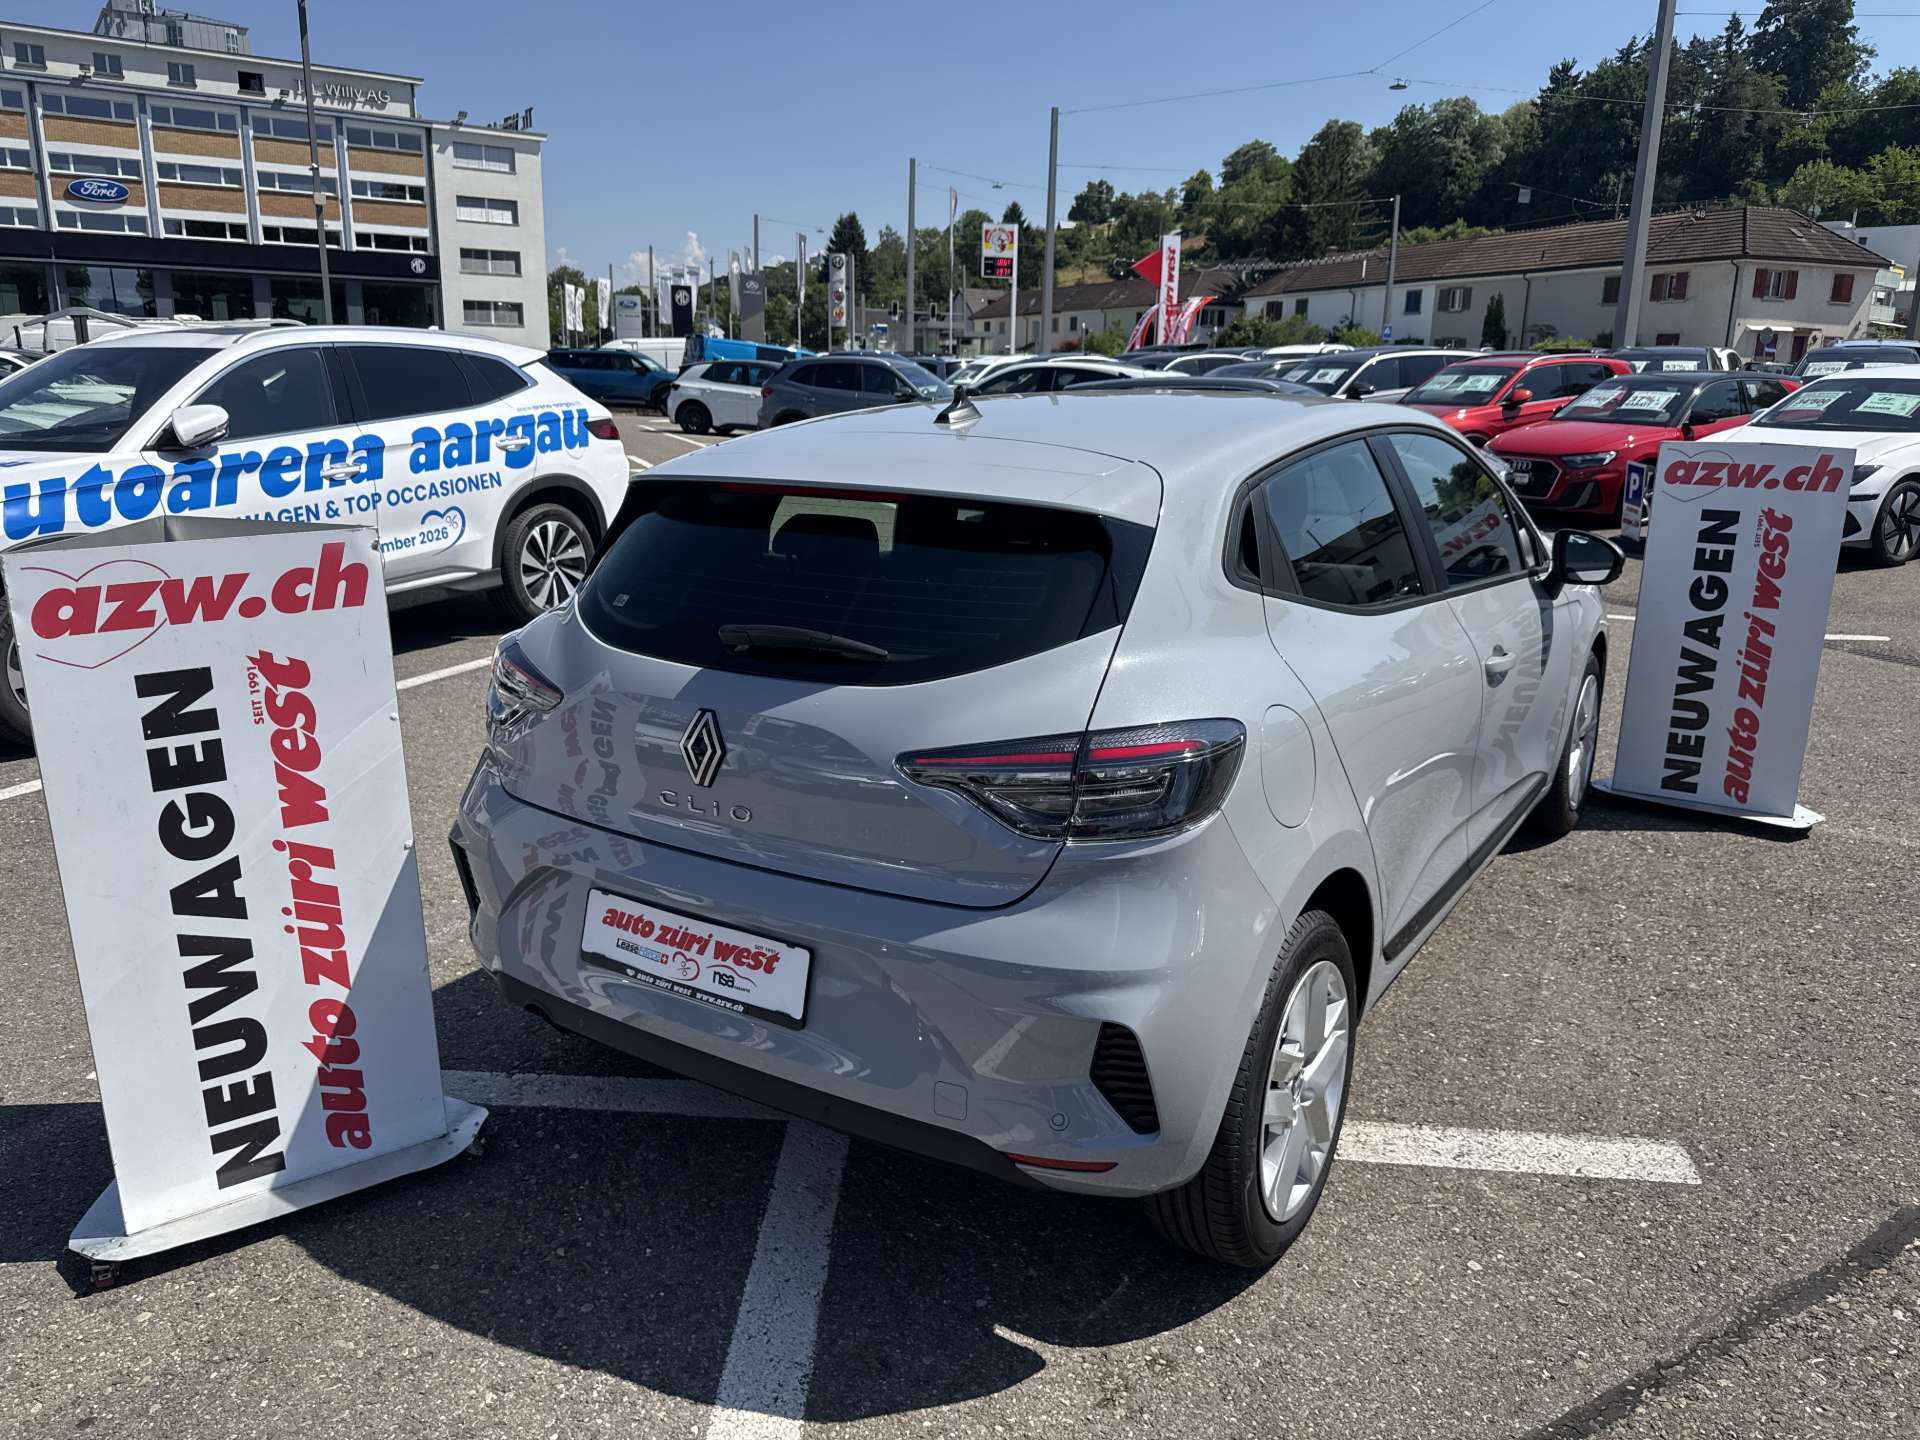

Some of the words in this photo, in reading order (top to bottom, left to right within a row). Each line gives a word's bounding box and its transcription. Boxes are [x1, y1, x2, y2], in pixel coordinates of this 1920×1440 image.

[367, 89, 390, 103] AG
[81, 181, 118, 197] Ford
[674, 289, 690, 306] MG
[409, 408, 589, 474] aargau
[325, 501, 340, 518] &
[344, 492, 381, 513] TOP
[387, 475, 502, 506] OCCASIONEN
[1629, 472, 1640, 499] P
[1664, 454, 1844, 492] azw.ch
[419, 526, 449, 545] 2026
[1752, 507, 1794, 609] west
[31, 542, 369, 640] azw.ch
[1660, 509, 1740, 794] NEUWAGEN
[1736, 611, 1776, 709] züri
[247, 666, 261, 696] 1991
[246, 649, 330, 828] west
[250, 700, 264, 725] SEIT
[1723, 707, 1760, 804] auto
[134, 666, 286, 1189] NEUWAGEN
[272, 839, 351, 990] züri
[602, 907, 655, 938] auto
[654, 926, 713, 956] züri
[713, 940, 780, 974] west
[673, 985, 692, 996] west
[696, 992, 744, 1013] www.azw.ch
[713, 970, 735, 989] nsa
[301, 997, 372, 1151] auto
